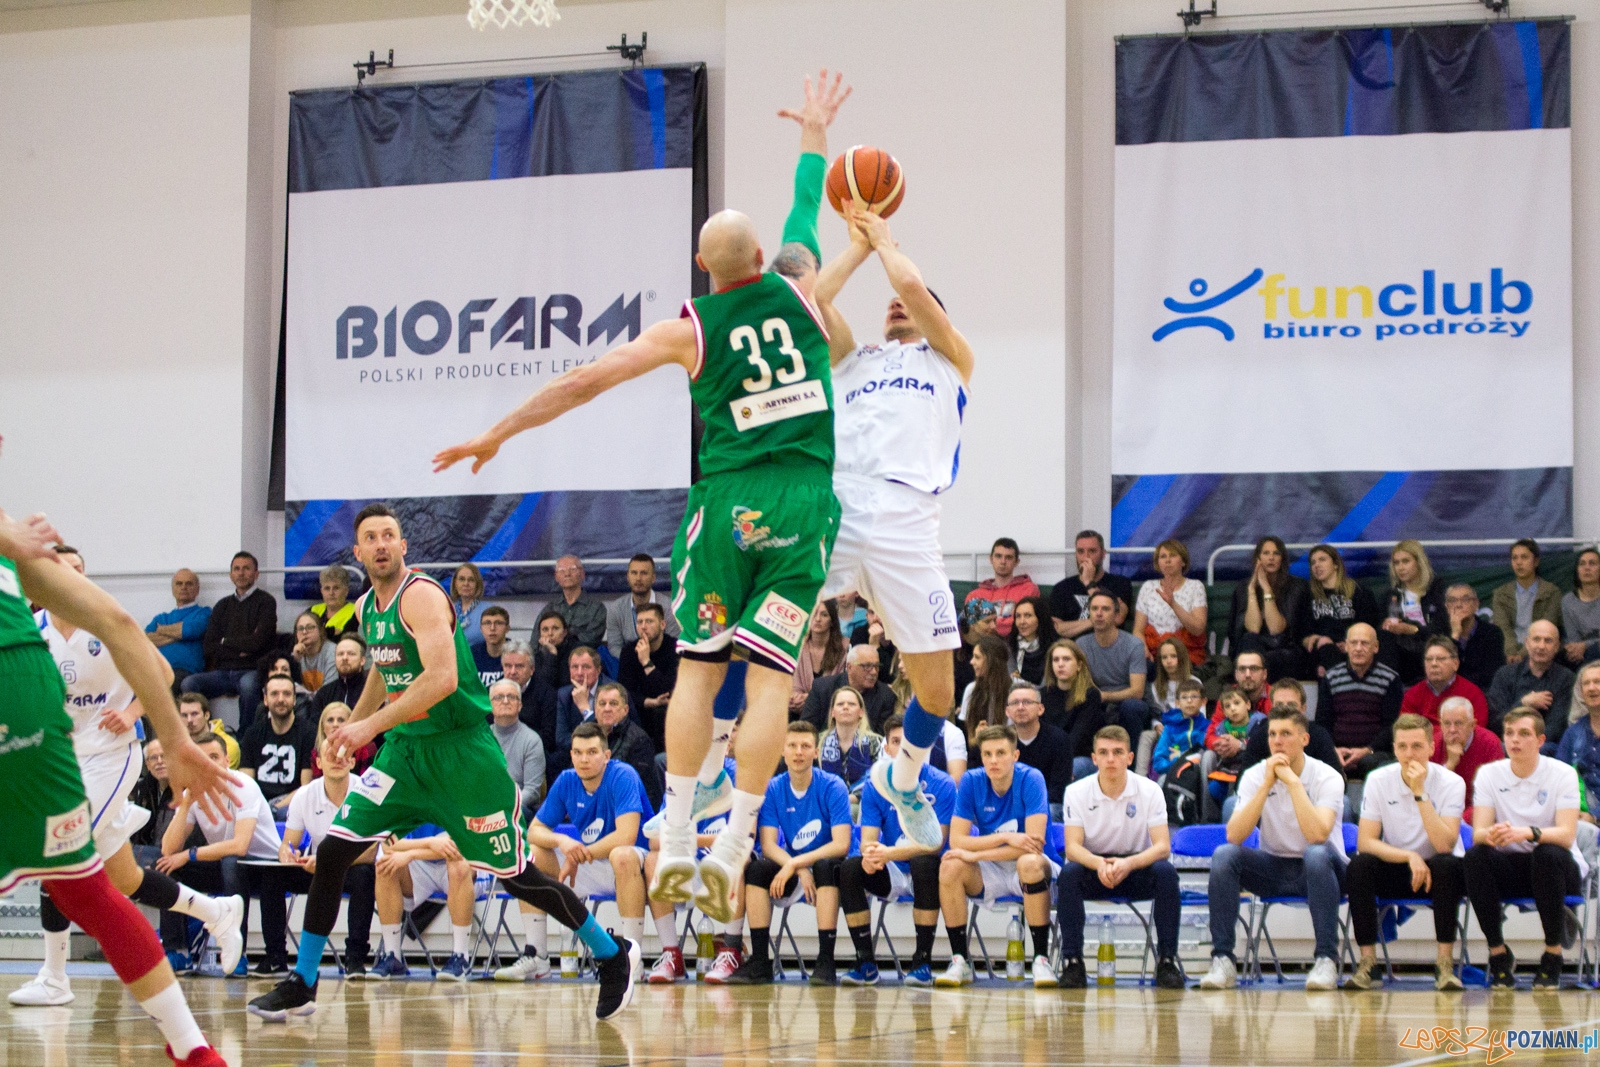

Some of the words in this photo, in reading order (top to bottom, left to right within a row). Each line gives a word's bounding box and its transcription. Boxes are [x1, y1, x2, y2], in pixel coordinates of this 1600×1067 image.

[335, 291, 642, 359] BIOFARM
[1263, 322, 1362, 339] biuro
[1376, 316, 1532, 341] podróży
[729, 317, 807, 393] 33
[359, 367, 423, 383] POLSKI
[435, 361, 543, 380] PRODUCENT
[845, 376, 936, 404] BIOFARM
[929, 590, 952, 625] 2
[375, 621, 386, 640] 30
[257, 744, 298, 783] 23
[489, 833, 512, 855] 30
